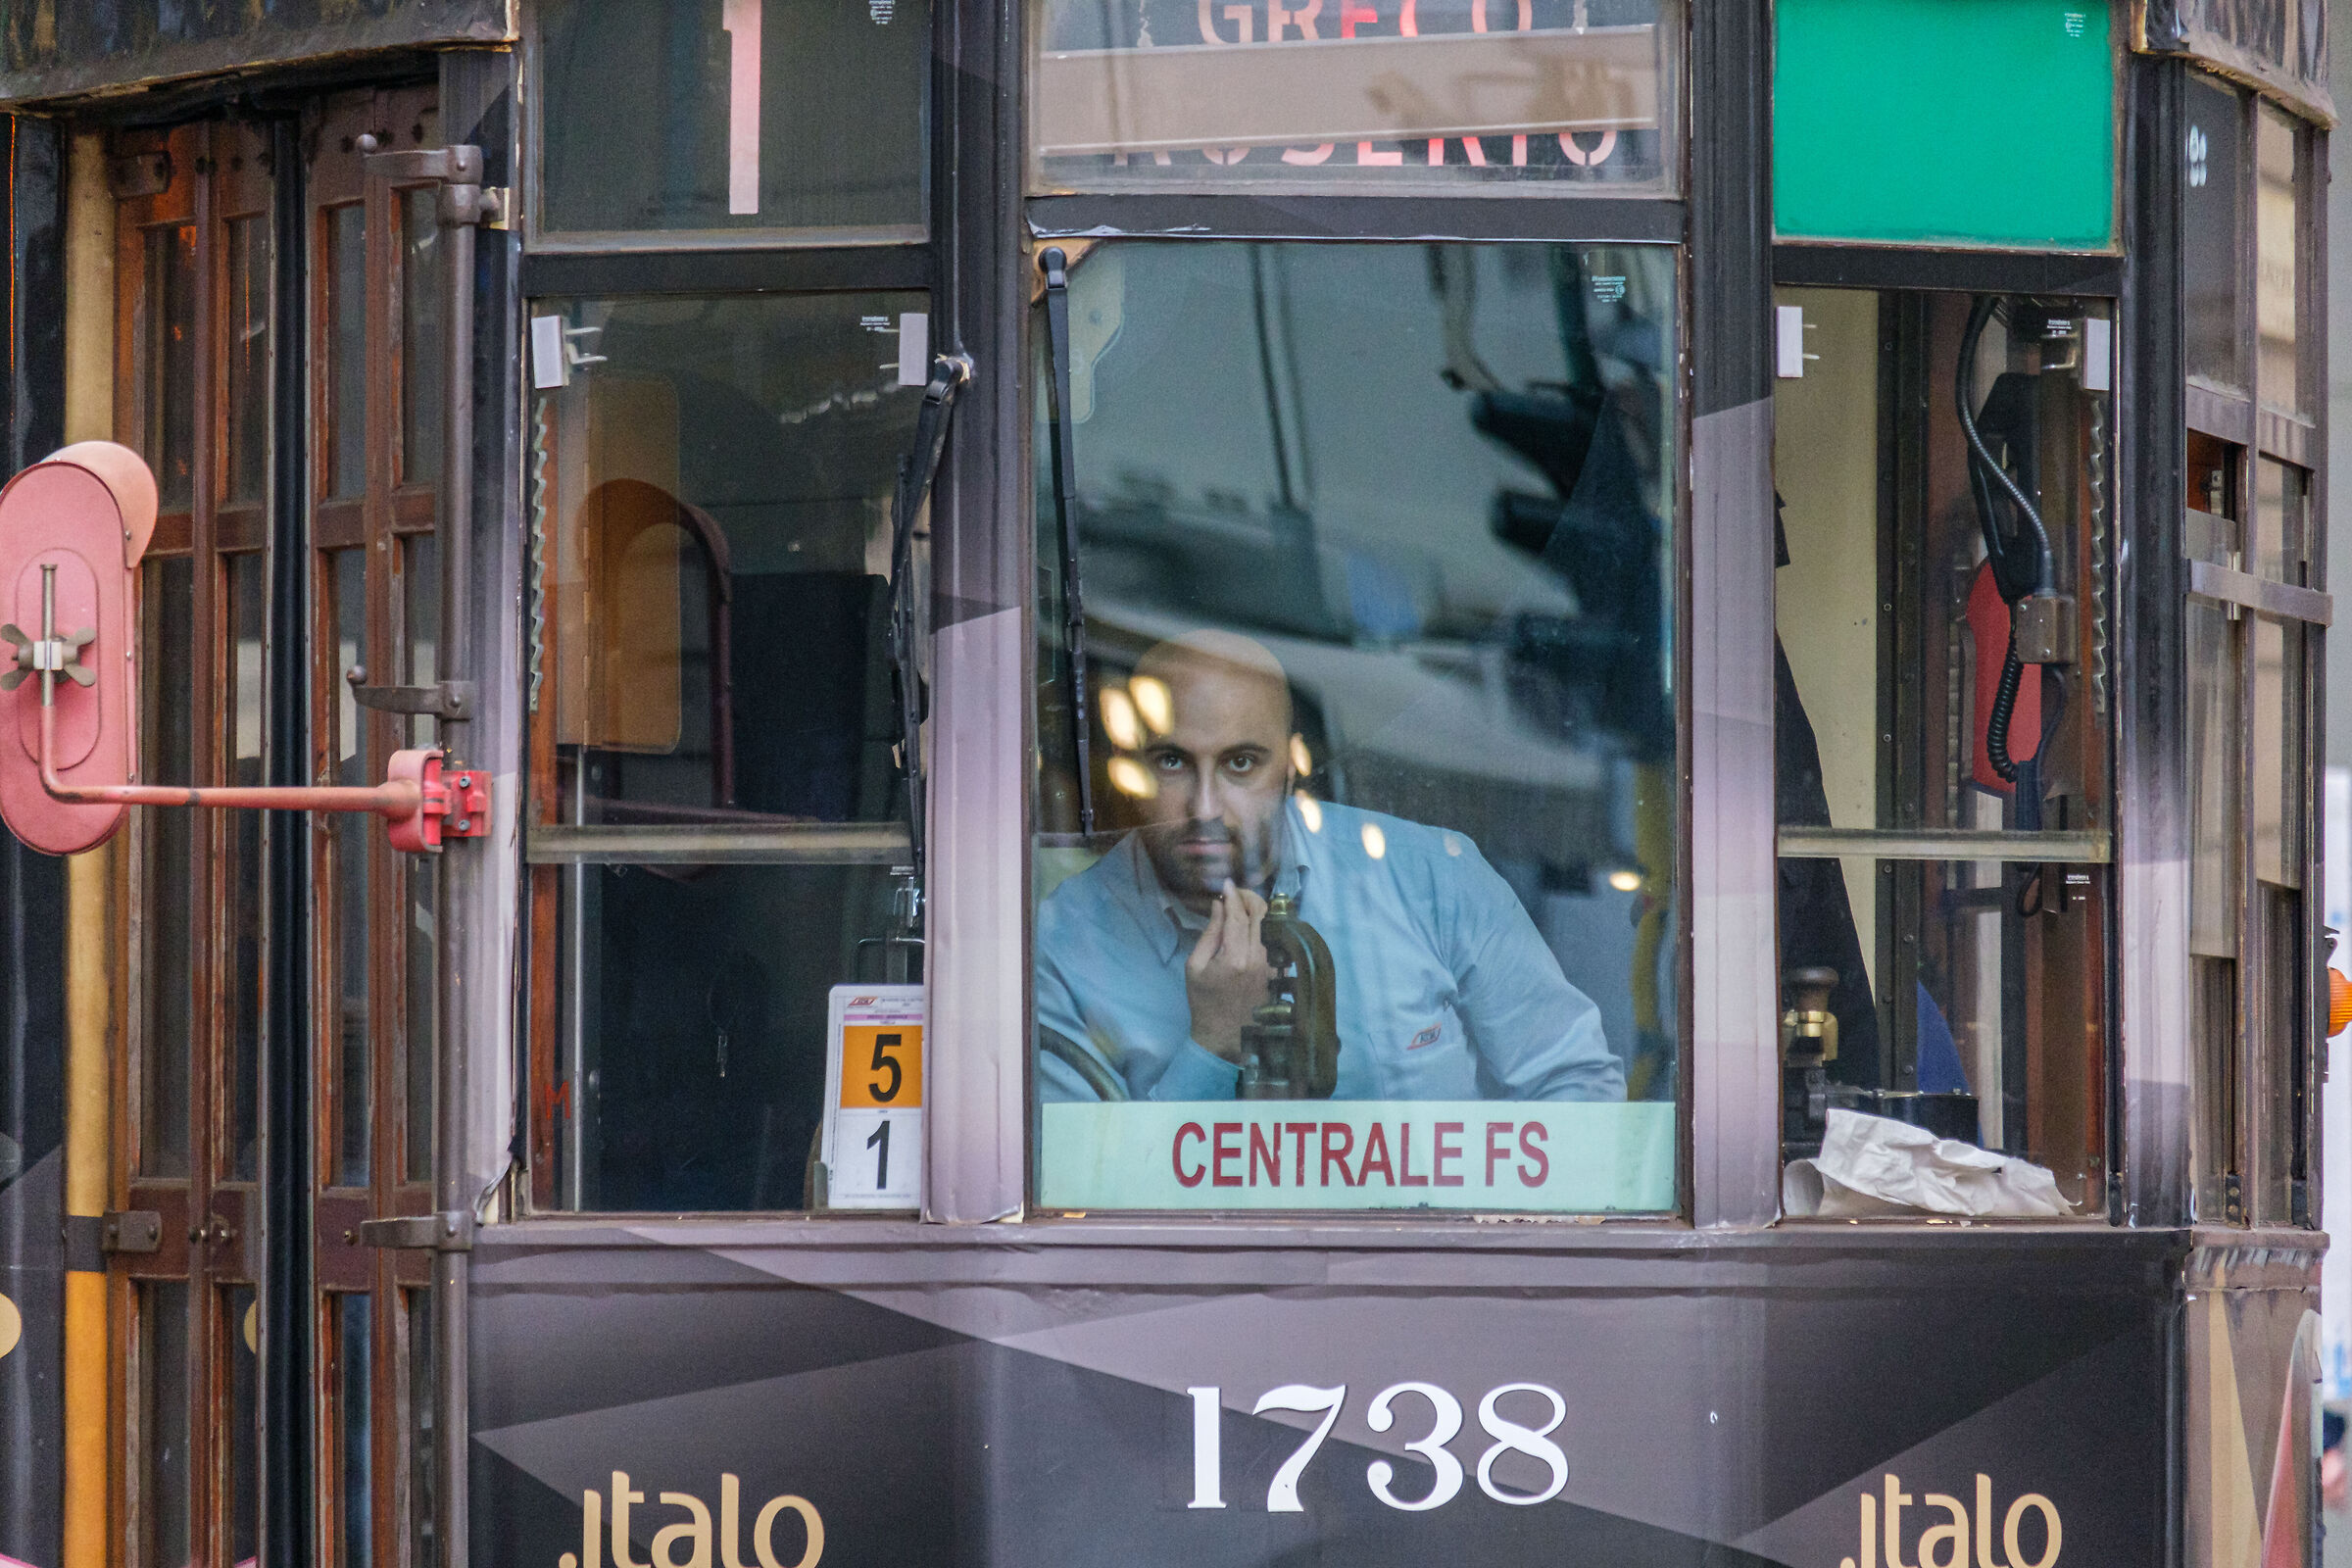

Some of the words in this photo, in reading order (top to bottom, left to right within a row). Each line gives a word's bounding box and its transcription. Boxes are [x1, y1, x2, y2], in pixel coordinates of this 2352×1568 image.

[868, 1034, 902, 1102] 5
[866, 1120, 890, 1190] 1
[1172, 1122, 1464, 1188] CENTRALE
[1485, 1121, 1549, 1188] FS
[1187, 1382, 1568, 1512] 1738
